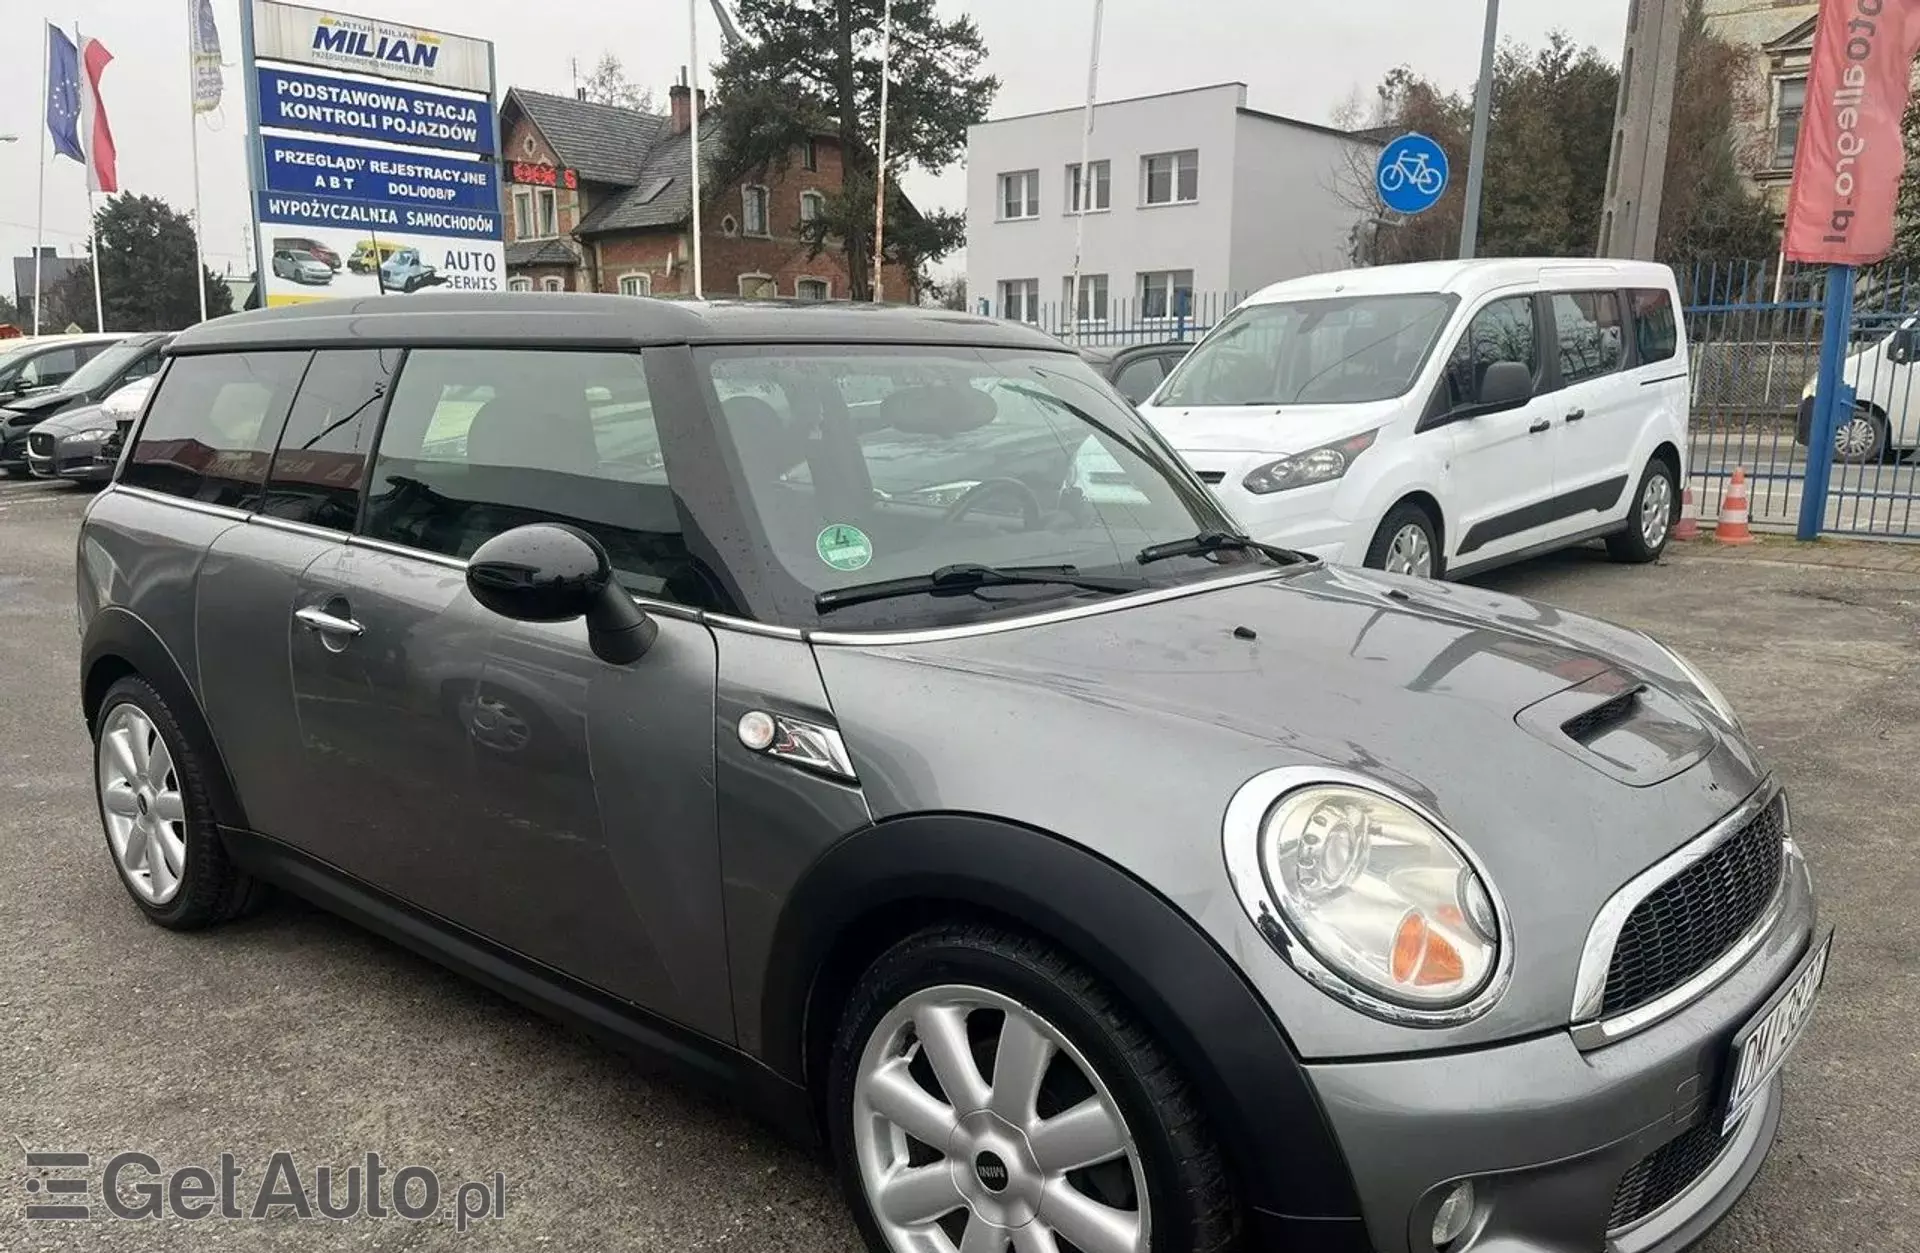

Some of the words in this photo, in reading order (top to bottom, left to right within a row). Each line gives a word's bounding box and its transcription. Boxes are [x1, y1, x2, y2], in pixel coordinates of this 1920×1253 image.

[313, 26, 438, 67] MILIAN
[276, 79, 409, 113] PODSTAWOWA
[413, 99, 478, 124] STACJA
[280, 101, 377, 129] KONTROLI
[382, 114, 478, 144] POJAZDÓW
[274, 149, 366, 173] PRZEGLĄDY
[370, 162, 487, 187] REJESTRACYJNE
[314, 174, 326, 188] A
[330, 176, 341, 189] B
[344, 178, 354, 190] T
[388, 181, 456, 201] DOL/008/P
[268, 198, 398, 225] WYPOŻYCZALNIA
[406, 210, 494, 233] SAMOCHODÓW
[444, 250, 496, 273] AUTO
[445, 274, 498, 291] SERWIS
